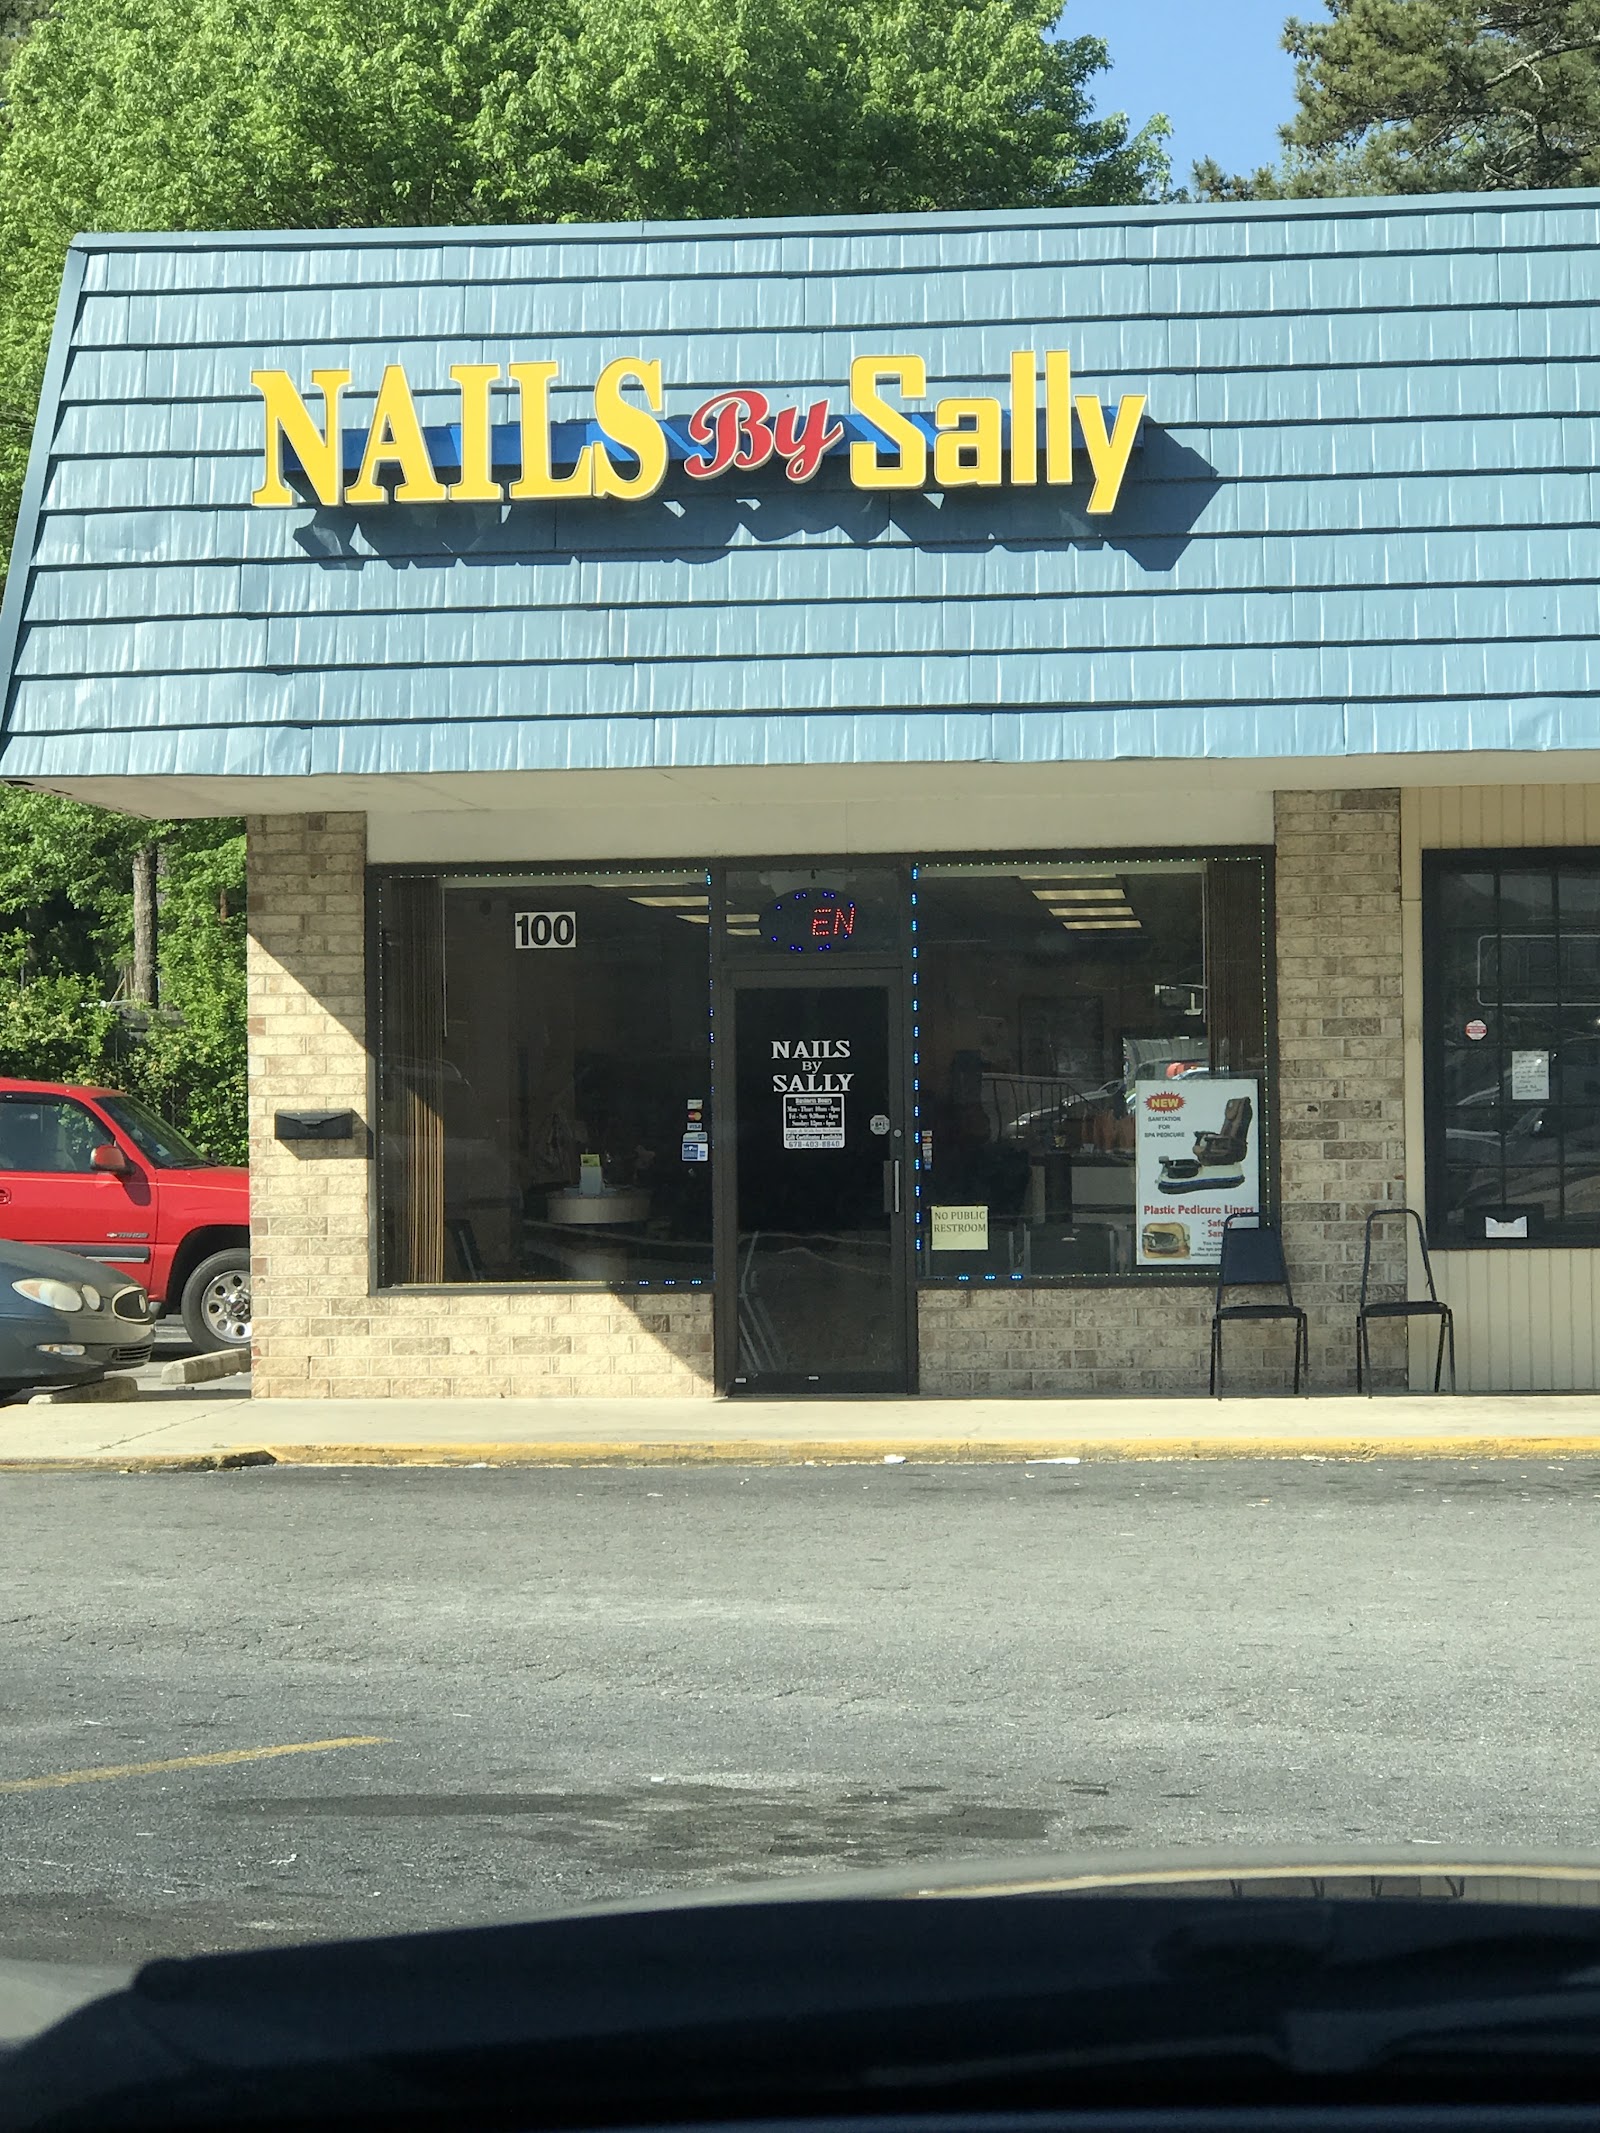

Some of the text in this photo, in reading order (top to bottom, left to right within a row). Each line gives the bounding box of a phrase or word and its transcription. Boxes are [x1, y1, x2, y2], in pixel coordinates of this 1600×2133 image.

[250, 349, 1146, 514] NAILS By Sally
[517, 914, 574, 945] 100
[771, 1040, 851, 1058] NAILS
[772, 1074, 854, 1092] SALLY
[1151, 1099, 1179, 1107] NEW
[935, 1211, 986, 1220] NO PUBLIC
[1144, 1205, 1254, 1215] Plastic Pedicure Liners
[934, 1223, 986, 1232] RESTROOM
